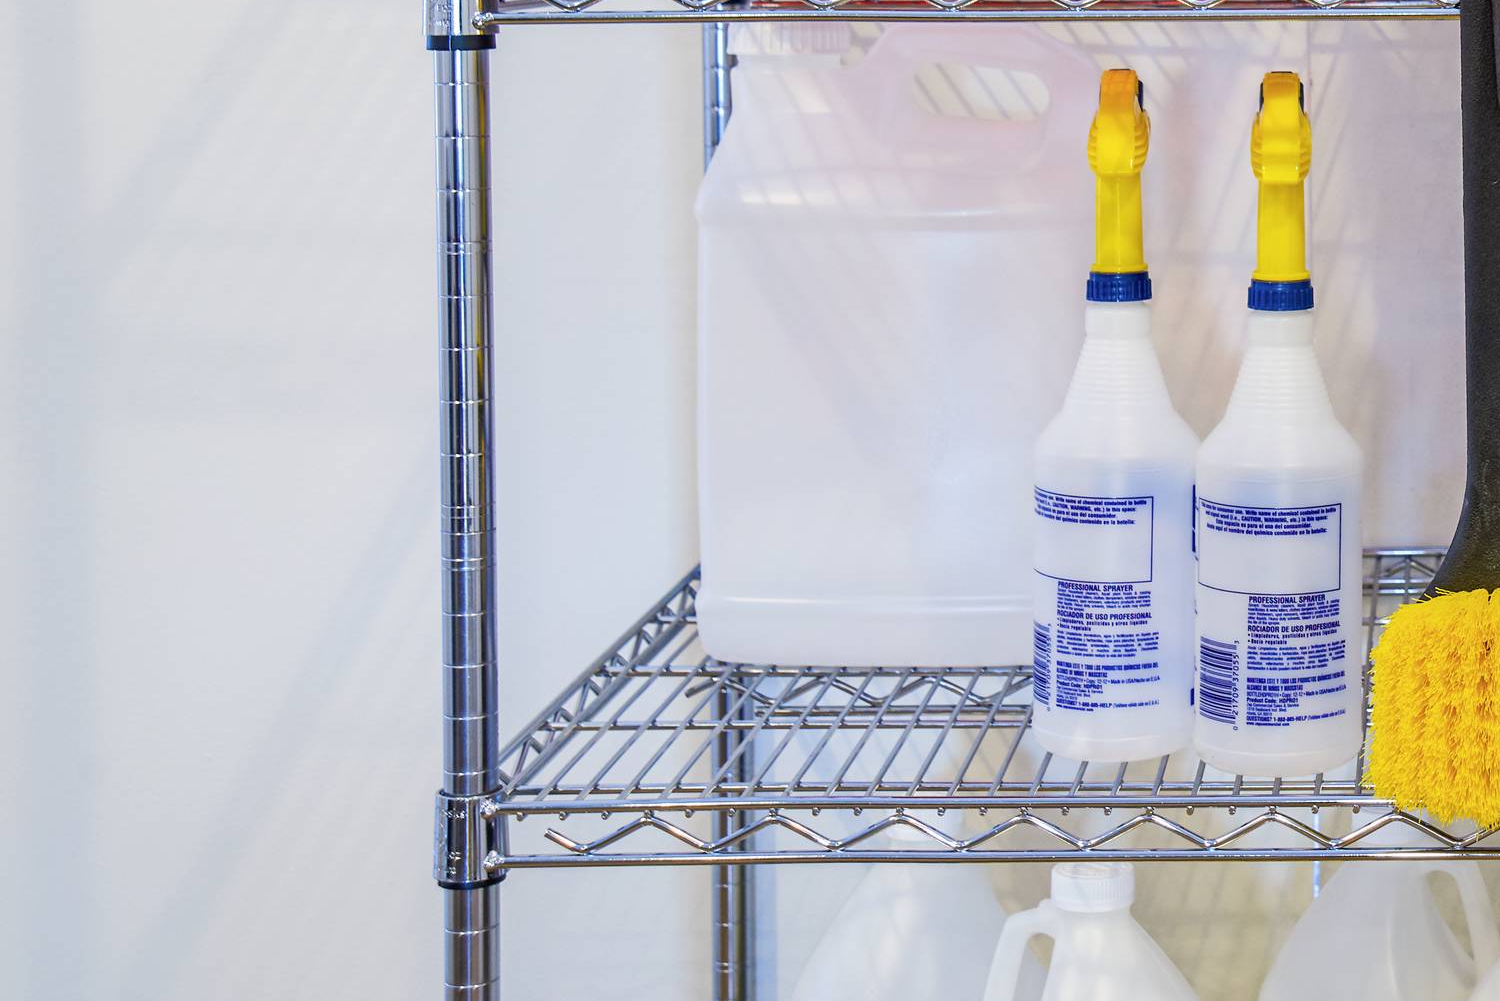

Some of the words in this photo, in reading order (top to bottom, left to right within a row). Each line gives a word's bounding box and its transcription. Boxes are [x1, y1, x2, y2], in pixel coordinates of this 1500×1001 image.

[1058, 581, 1101, 591] PROFESSIONAL
[1248, 596, 1297, 604] PROFESSIONAL
[1299, 594, 1326, 603] SPRAYER
[1057, 609, 1084, 619] ROCIADOR
[1110, 612, 1152, 620] PROFESIONAL
[1305, 621, 1340, 631] PROFESIONAL
